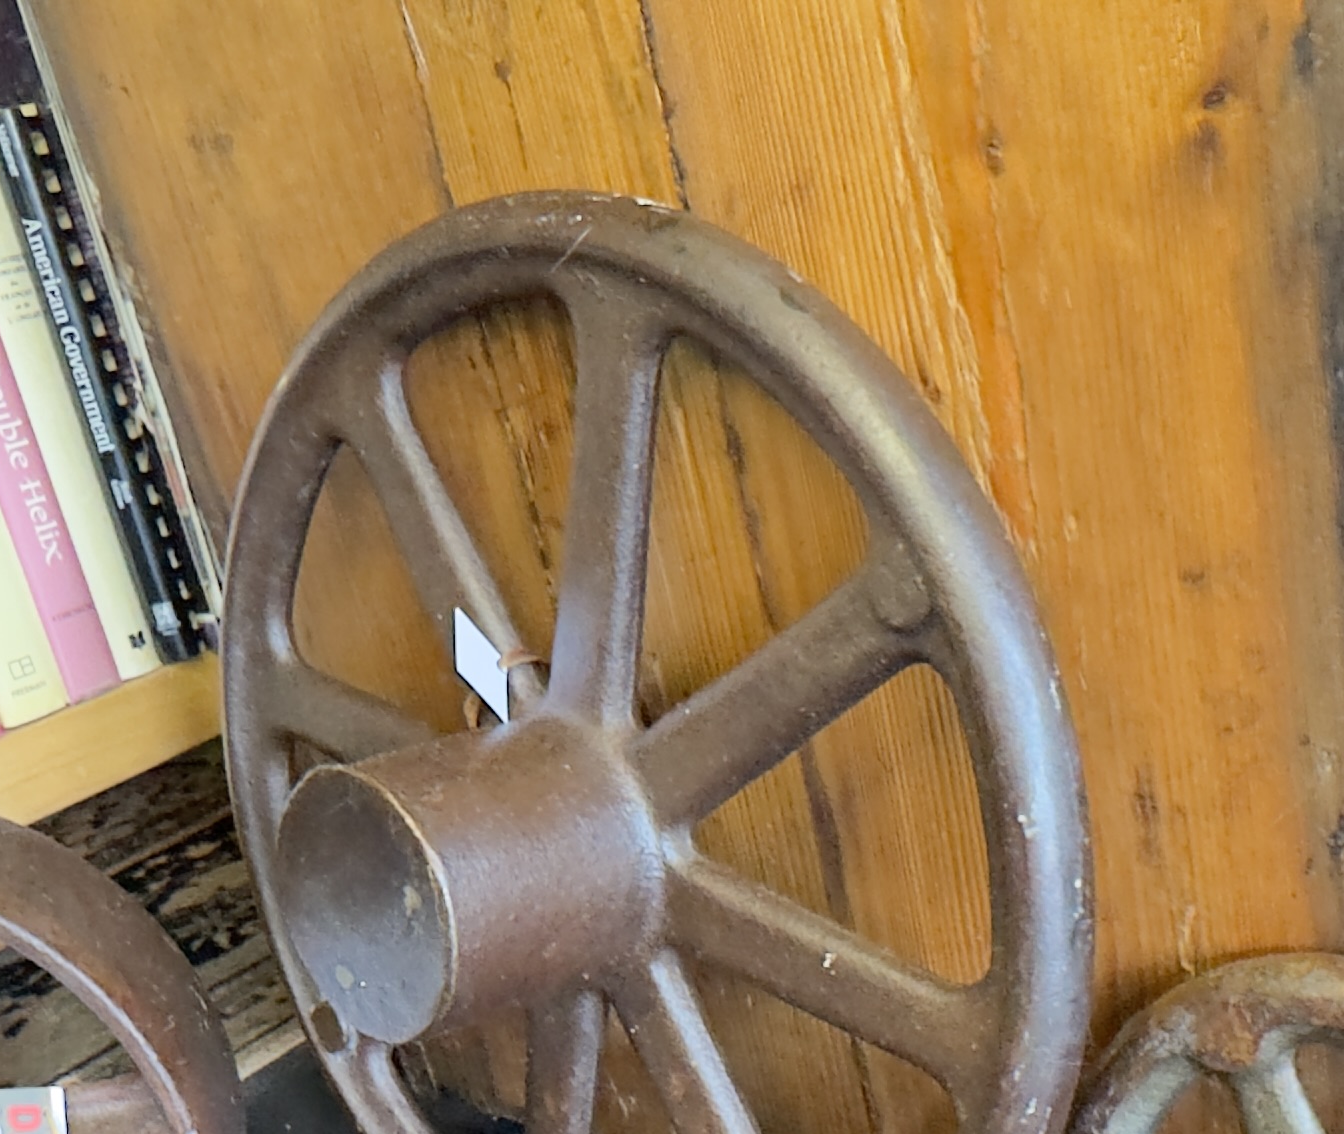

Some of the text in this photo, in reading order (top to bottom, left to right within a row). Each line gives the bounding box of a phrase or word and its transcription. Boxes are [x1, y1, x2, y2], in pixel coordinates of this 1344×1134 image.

[21, 218, 116, 454] American Government
[18, 479, 63, 567] Helix
